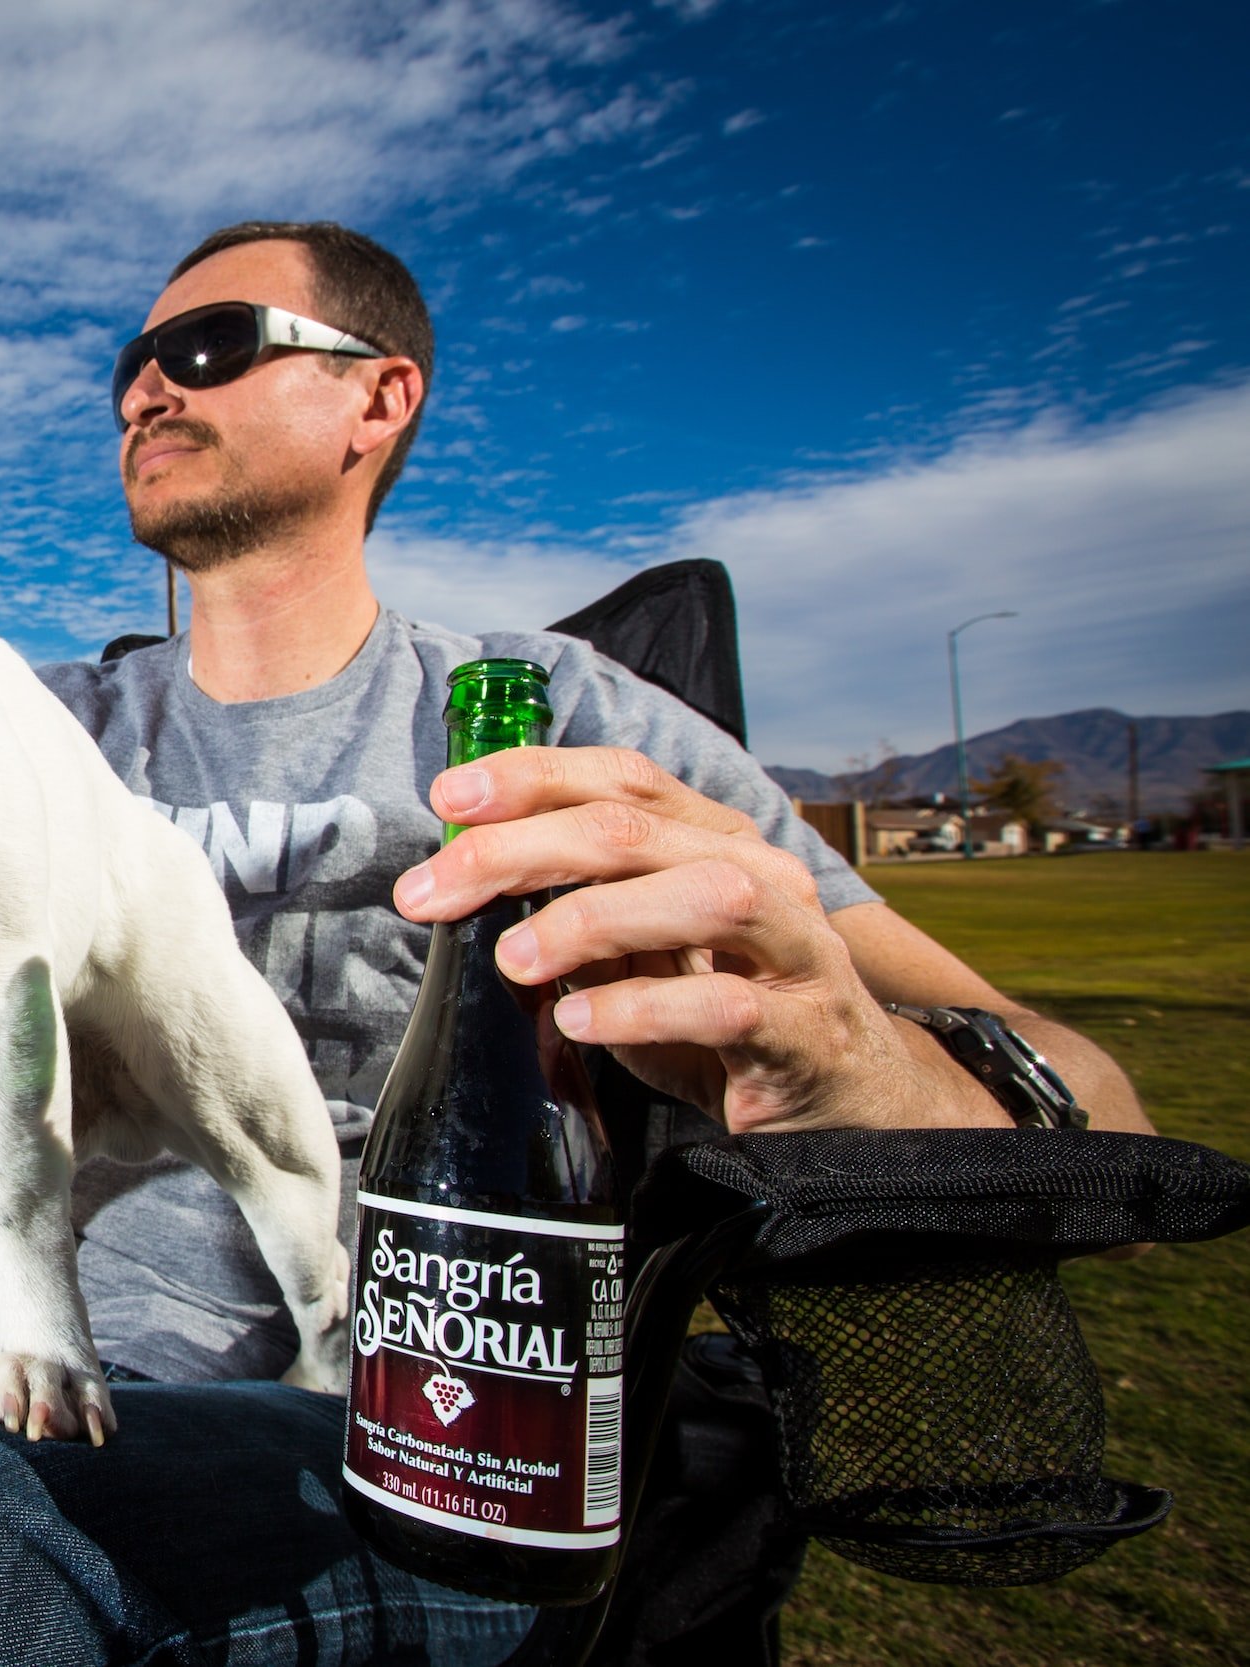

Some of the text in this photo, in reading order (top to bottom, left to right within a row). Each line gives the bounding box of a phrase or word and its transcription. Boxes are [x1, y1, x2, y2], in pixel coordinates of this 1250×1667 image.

[371, 1228, 544, 1312] Sangría
[592, 1279, 608, 1302] CA
[355, 1279, 579, 1374] SEÑORIAL
[354, 1411, 560, 1478] Sangría Carbonatada Sin Alcohol
[367, 1436, 533, 1495] Sabor Natural Y Artificial
[381, 1470, 507, 1525] 330 mL (11.16 FL OZ)
